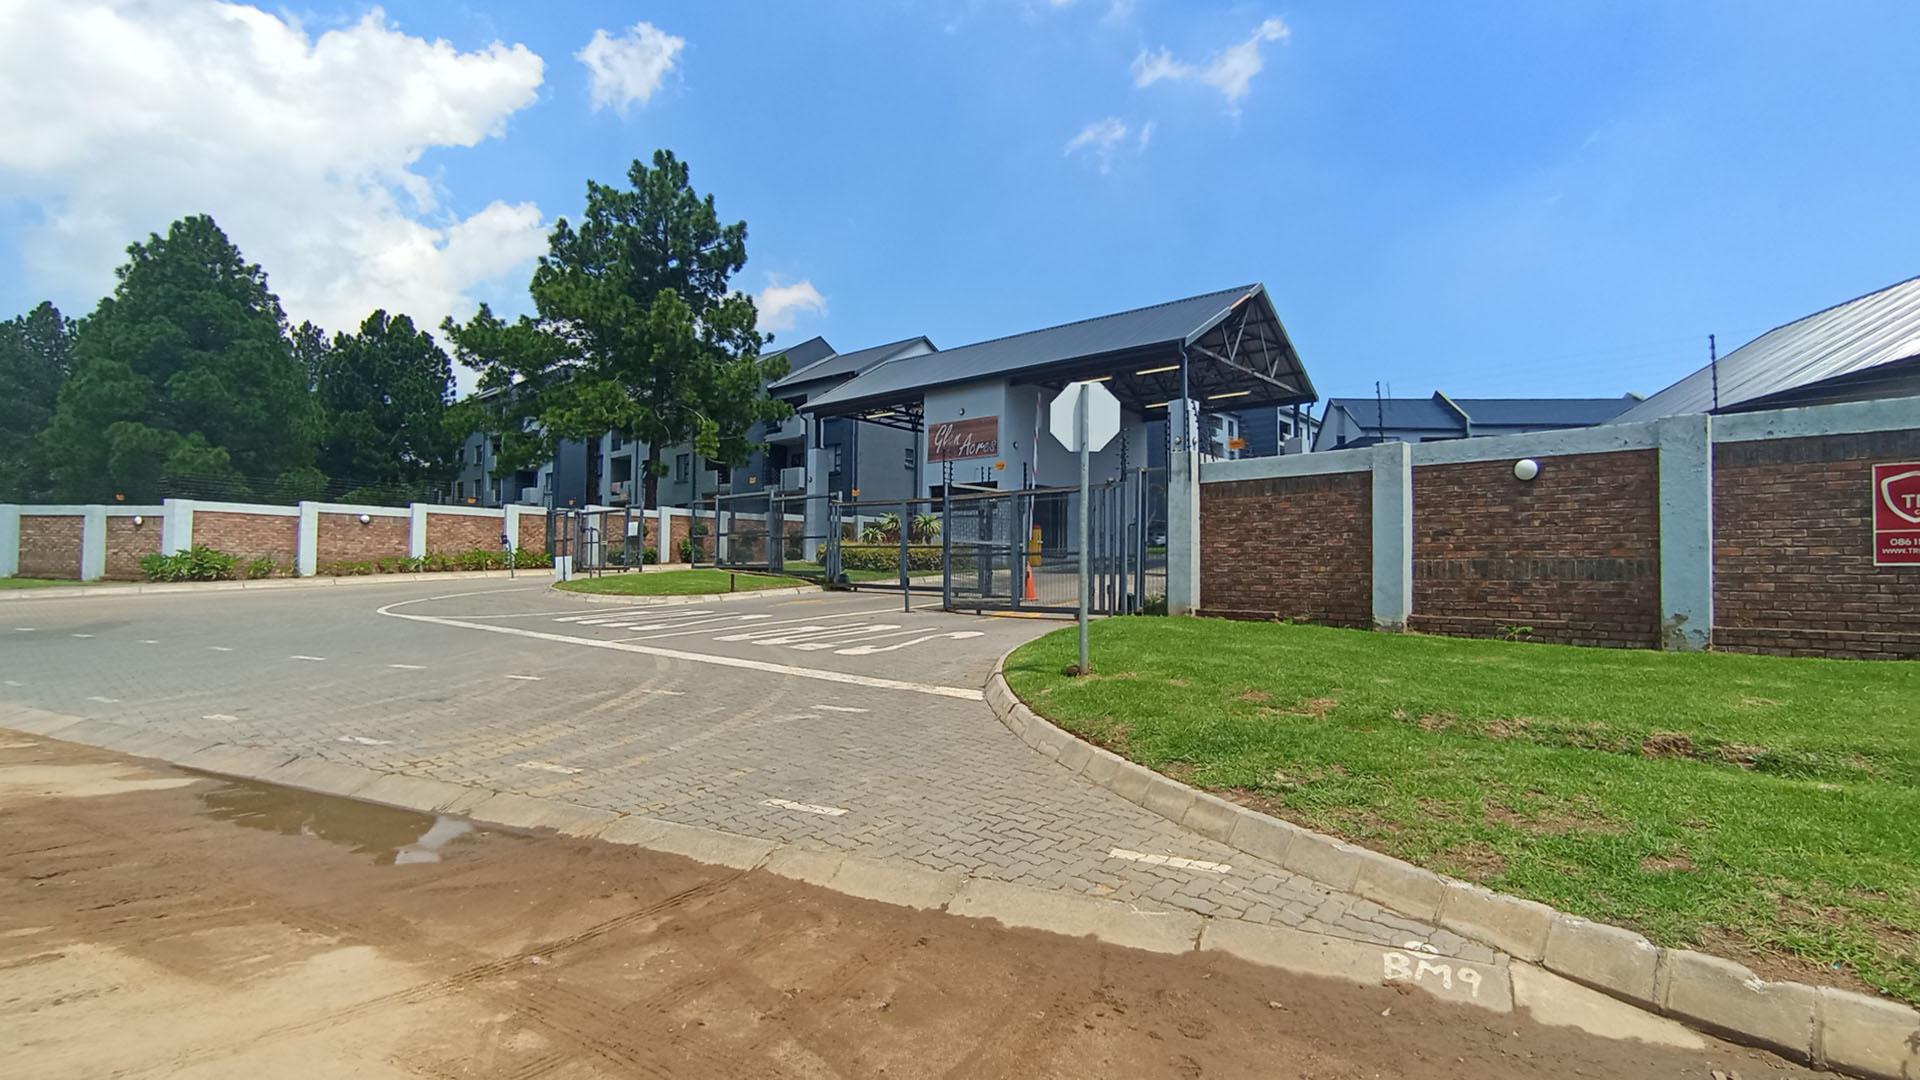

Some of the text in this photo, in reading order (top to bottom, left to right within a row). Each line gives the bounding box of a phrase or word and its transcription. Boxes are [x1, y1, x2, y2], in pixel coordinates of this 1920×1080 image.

[934, 424, 960, 454] Glen
[958, 433, 997, 456] Acres
[1890, 538, 1912, 546] 086
